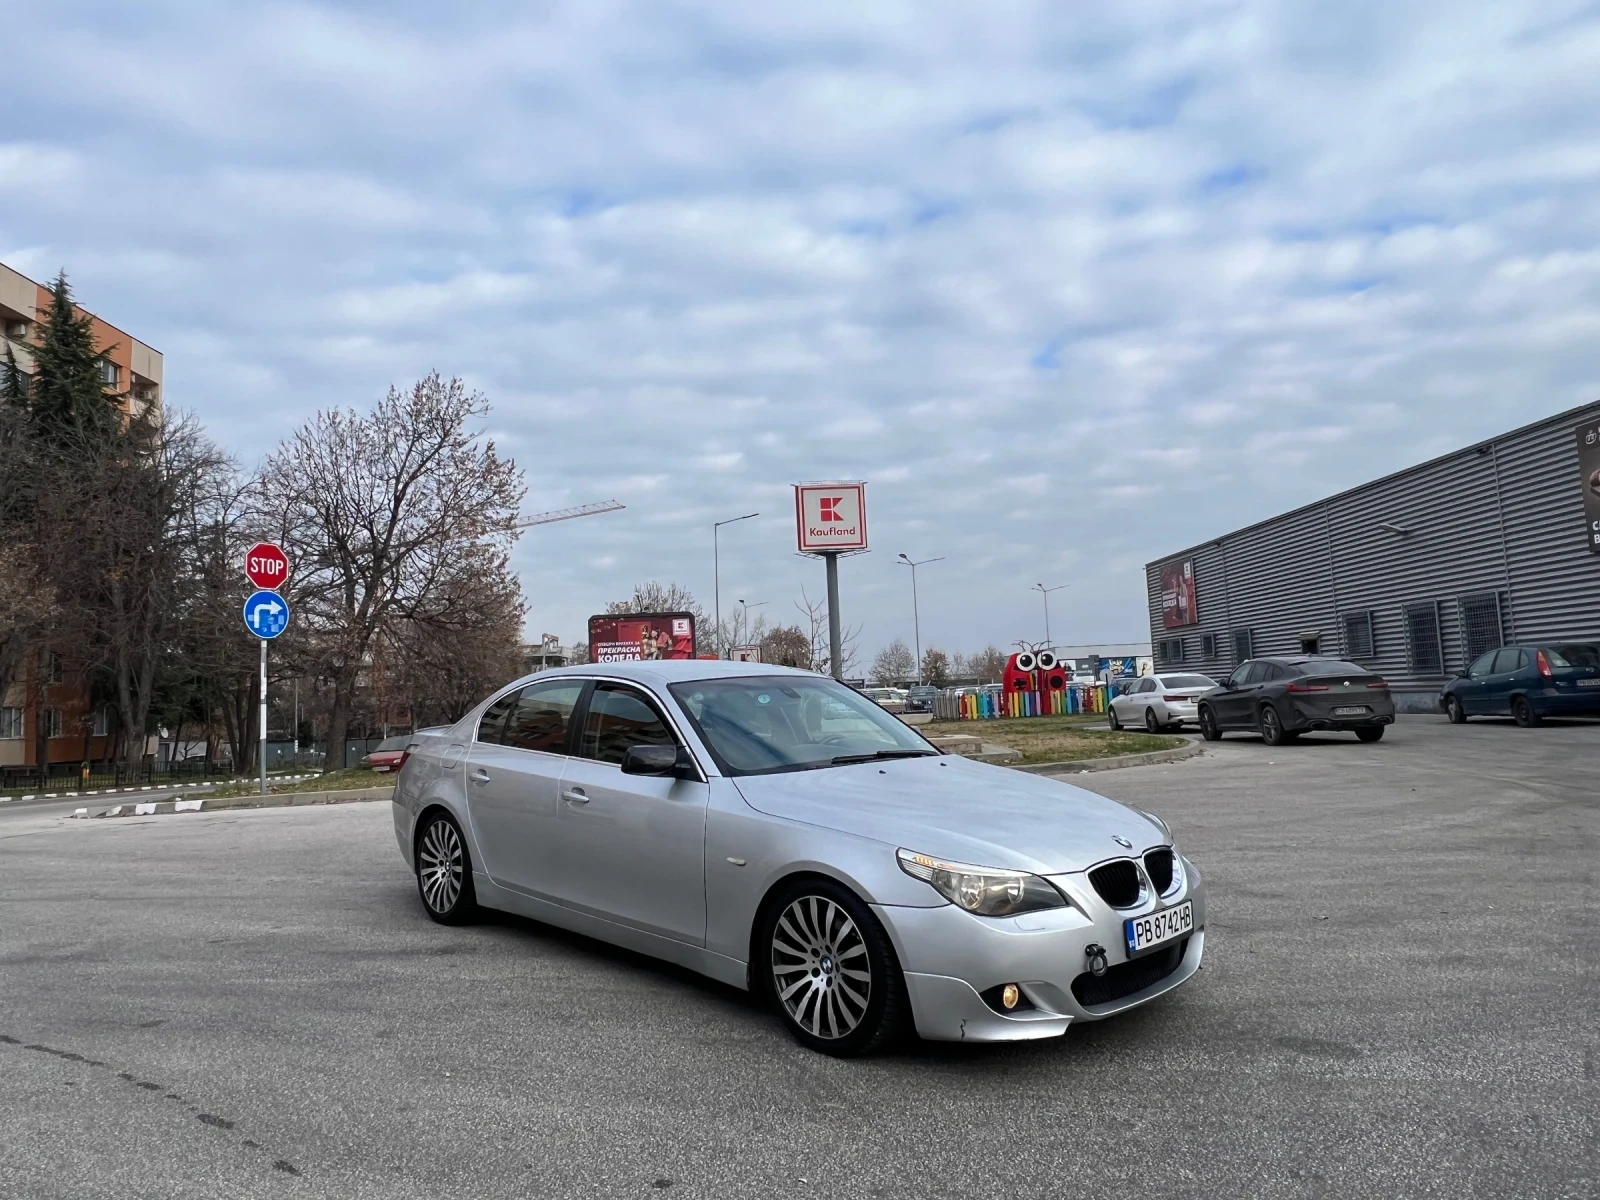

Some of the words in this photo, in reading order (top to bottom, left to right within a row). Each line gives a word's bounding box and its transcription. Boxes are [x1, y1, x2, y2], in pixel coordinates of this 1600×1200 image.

[809, 526, 856, 537] Kaufland
[250, 556, 284, 576] STOP
[597, 646, 641, 654] ПРЕКРАСНА
[598, 653, 641, 663] КОЛЕДА
[1135, 919, 1153, 947] PB
[1154, 910, 1180, 940] 8742
[1179, 905, 1191, 931] HB
